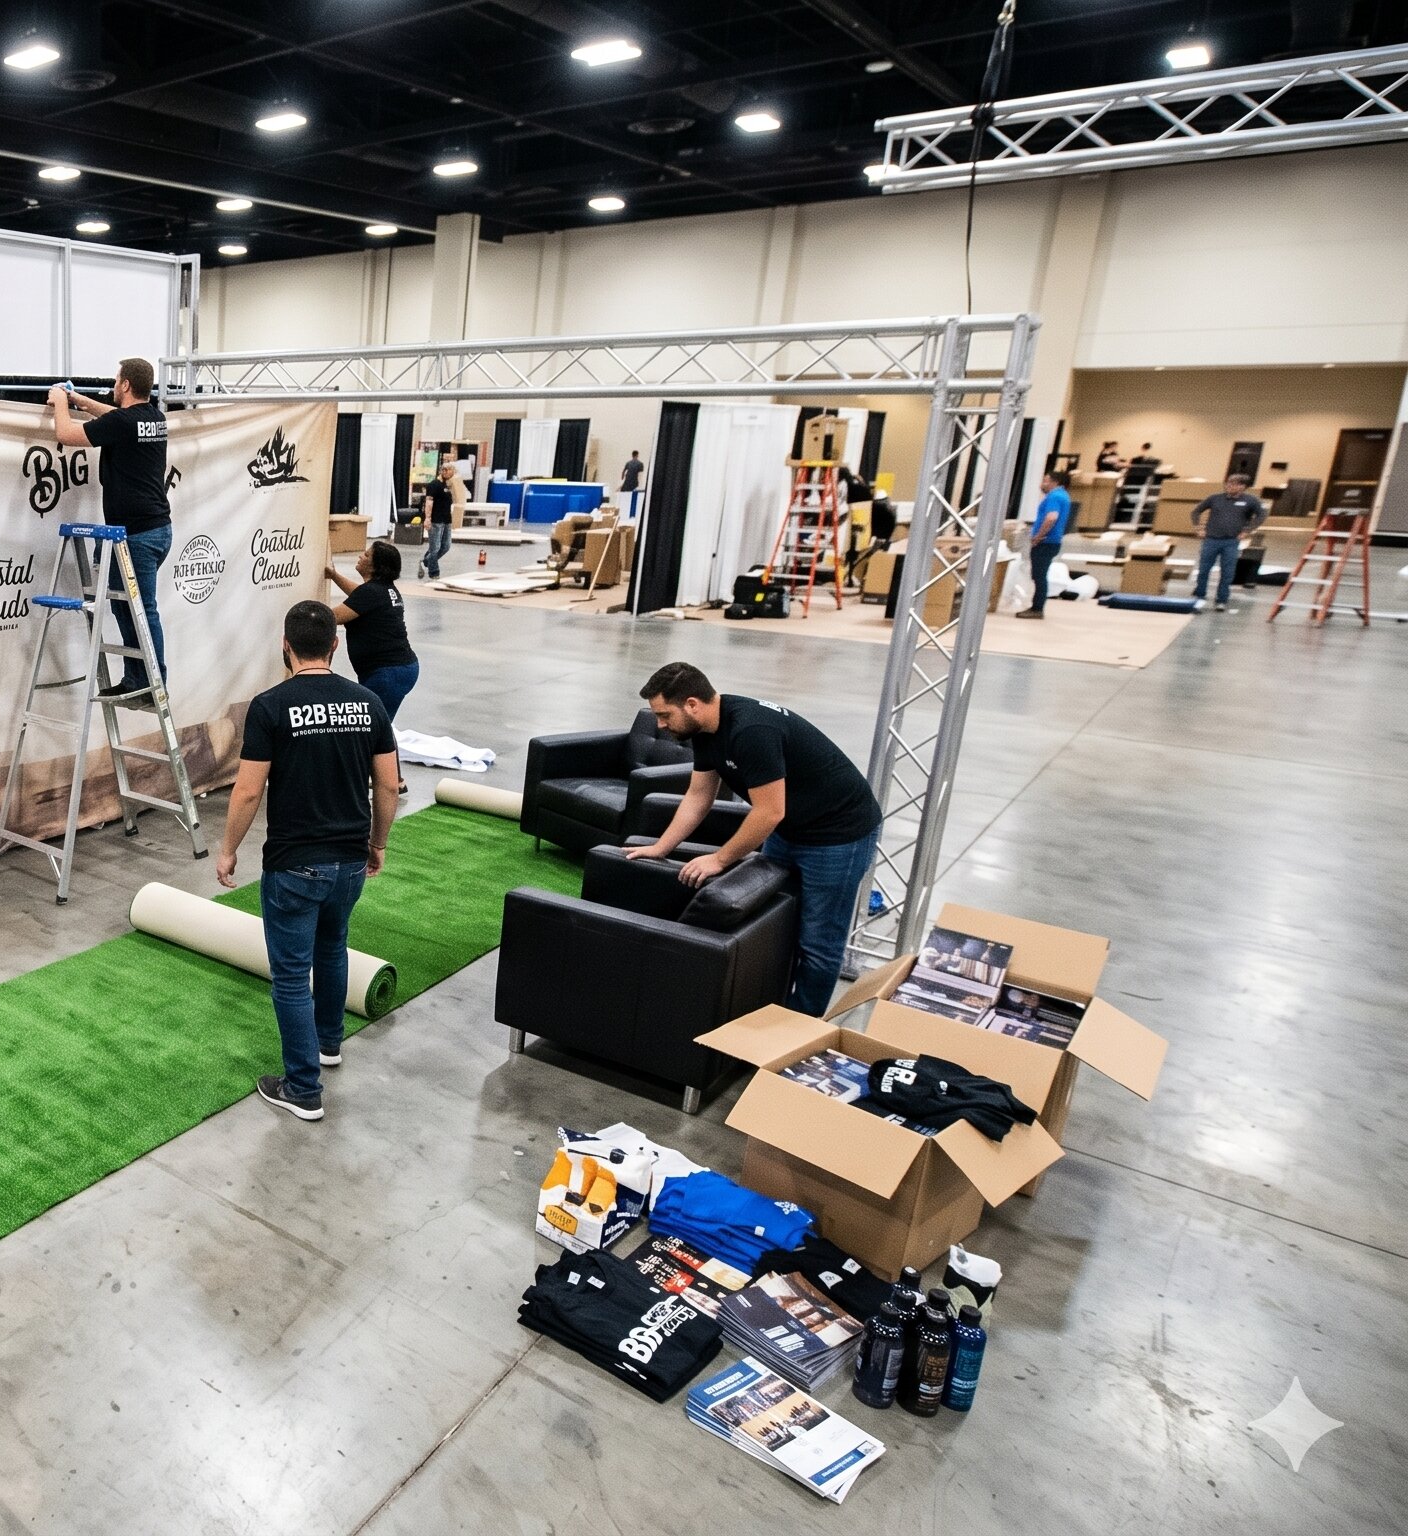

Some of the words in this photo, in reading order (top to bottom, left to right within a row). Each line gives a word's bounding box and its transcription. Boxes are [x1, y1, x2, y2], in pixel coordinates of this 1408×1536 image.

[251, 526, 305, 557] Coastal
[252, 555, 300, 585] Clouds
[288, 704, 327, 728] B2B
[327, 702, 369, 714] EVENT
[329, 714, 372, 725] PHOTO
